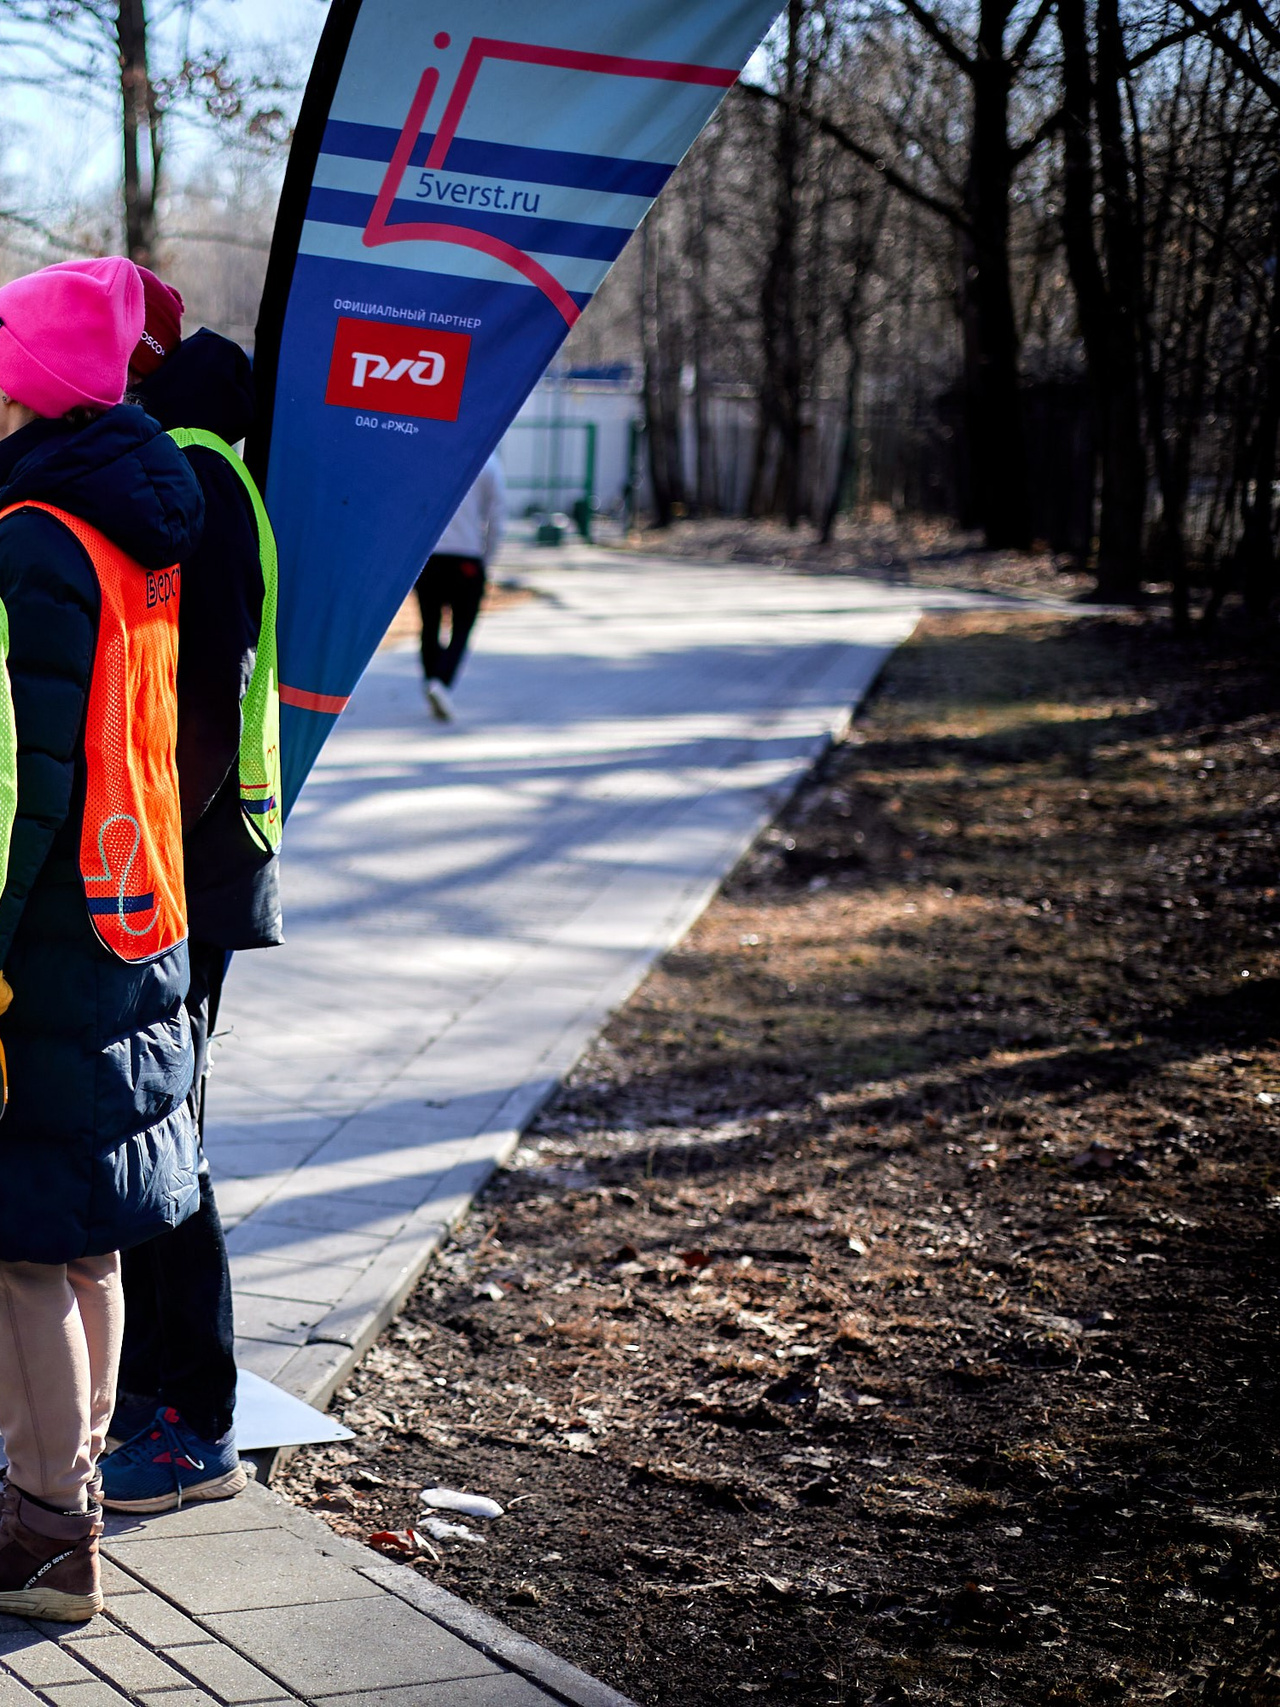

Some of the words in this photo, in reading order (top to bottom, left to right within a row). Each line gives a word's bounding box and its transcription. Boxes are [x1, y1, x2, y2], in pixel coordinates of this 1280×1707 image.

[416, 172, 540, 213] 5verst.ru
[333, 298, 426, 322] ОФИЦИАЛЬНЫЙ
[429, 312, 482, 329] ПАРТНЕР
[140, 330, 163, 354] OSCO
[355, 415, 379, 429] ОАО
